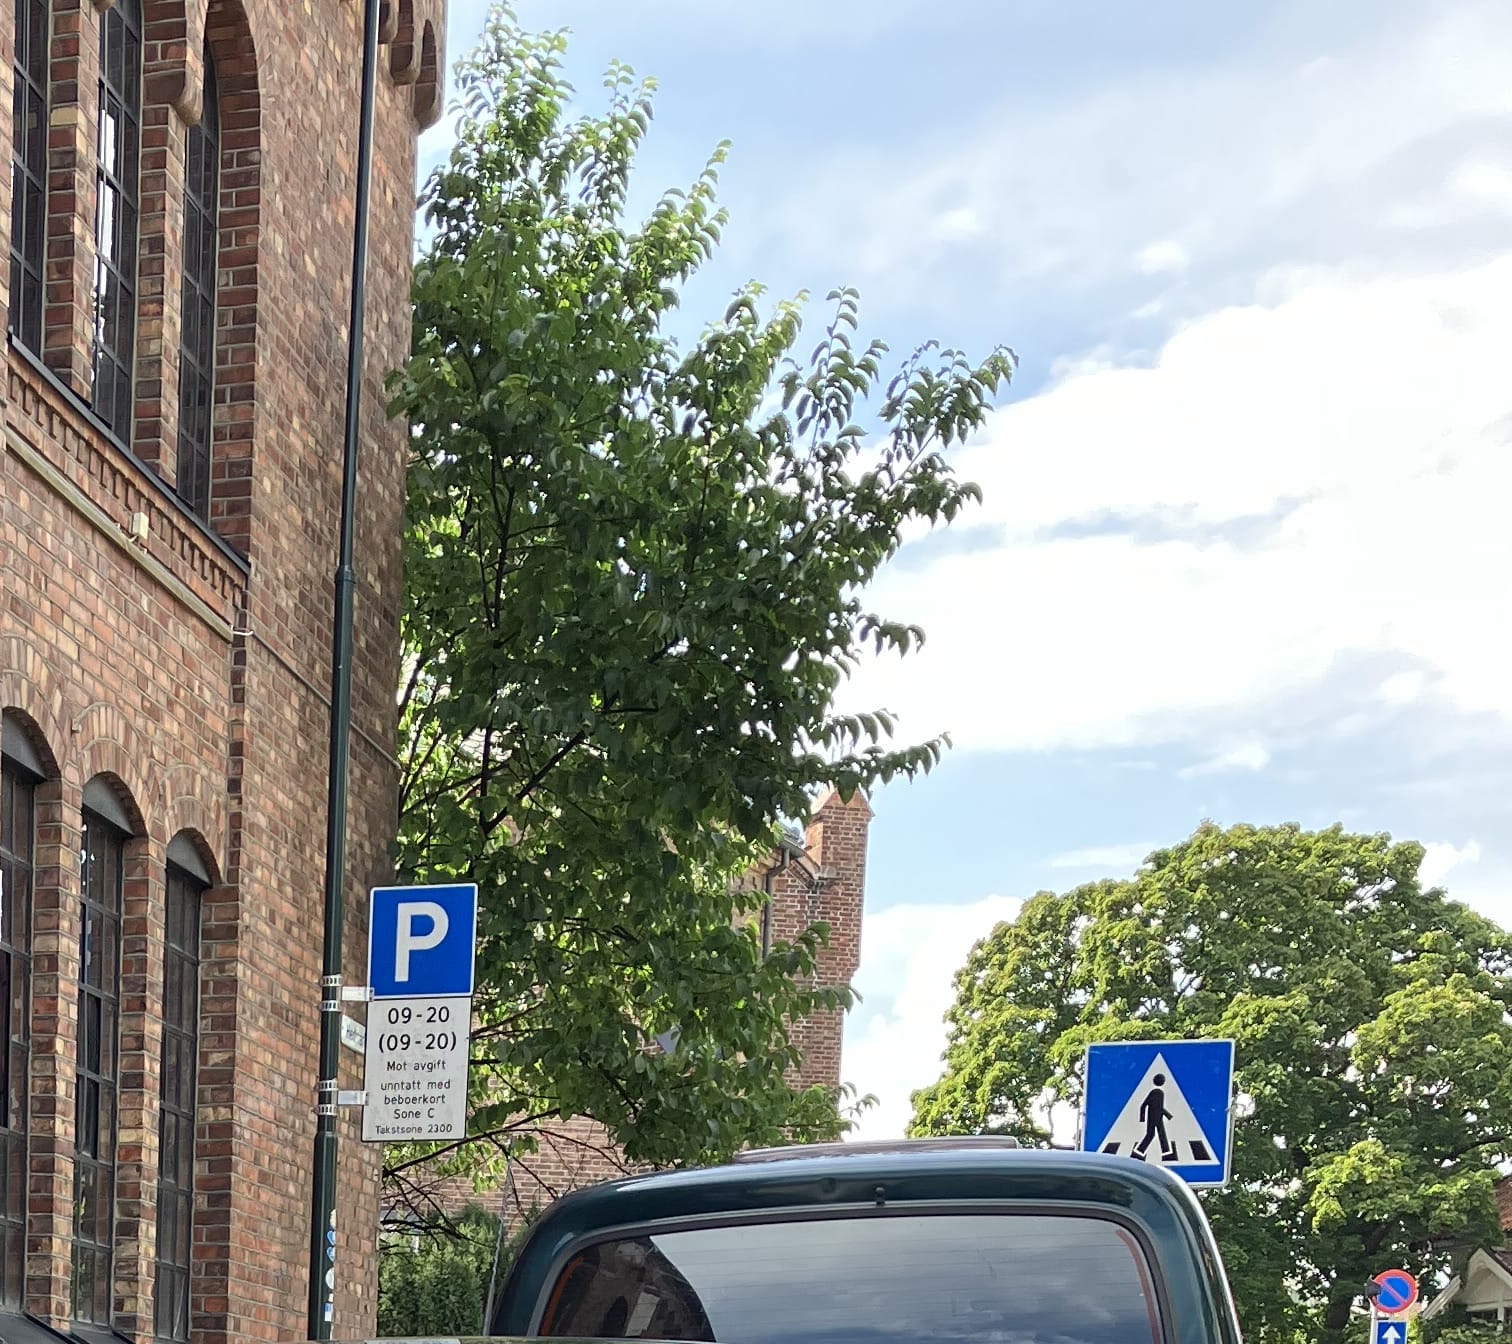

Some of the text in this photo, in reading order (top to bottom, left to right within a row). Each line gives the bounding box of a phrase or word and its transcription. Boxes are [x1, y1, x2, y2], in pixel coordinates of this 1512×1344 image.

[394, 901, 450, 983] P
[387, 1006, 450, 1024] 09-20
[378, 1031, 457, 1053] (09-20)
[386, 1060, 447, 1073] Mot avgift
[380, 1079, 451, 1091] unntatt med
[384, 1094, 446, 1105] beboerkort
[393, 1107, 436, 1119] Sone C
[375, 1123, 453, 1135] Takstsone 2300
